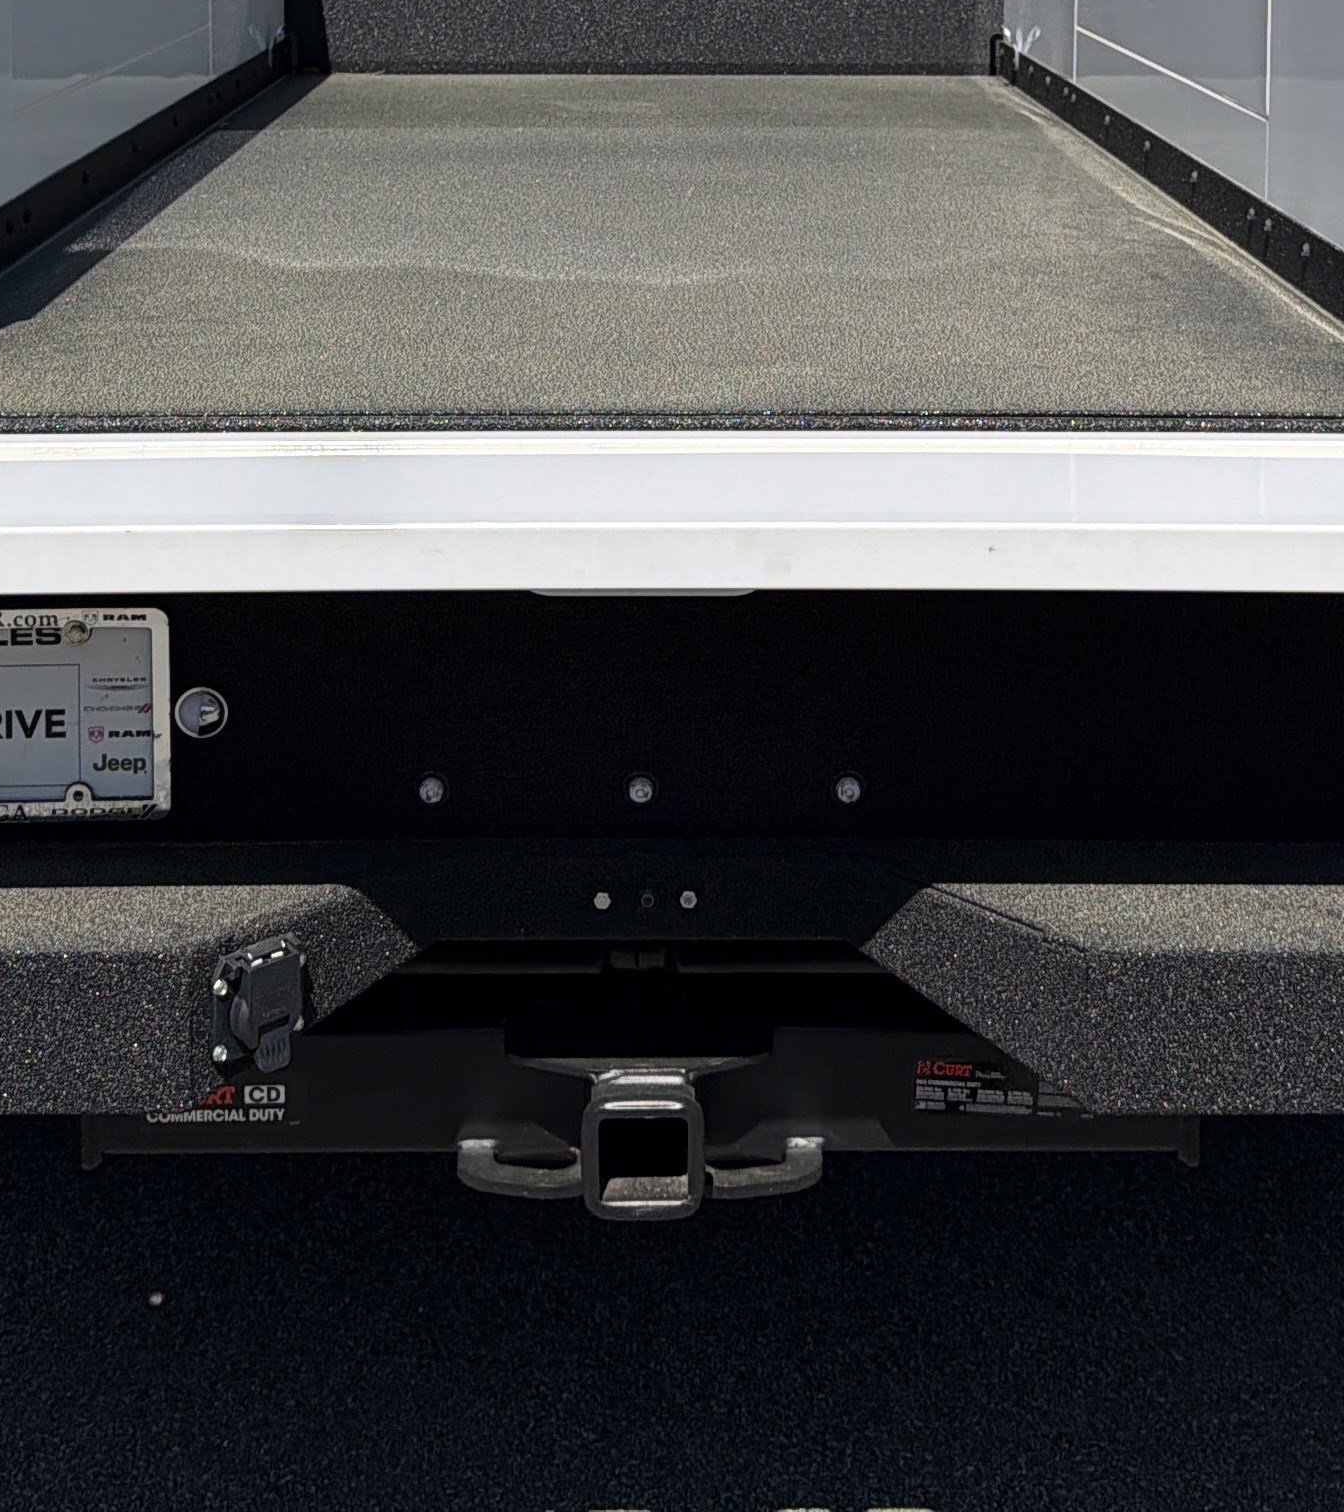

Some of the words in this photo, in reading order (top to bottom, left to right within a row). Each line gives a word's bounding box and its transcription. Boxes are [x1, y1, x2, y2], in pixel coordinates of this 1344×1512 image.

[103, 613, 148, 622] RAM
[108, 729, 152, 738] RAM
[92, 753, 148, 775] Jeep
[248, 1086, 281, 1102] CD
[248, 1108, 285, 1122] DUTY
